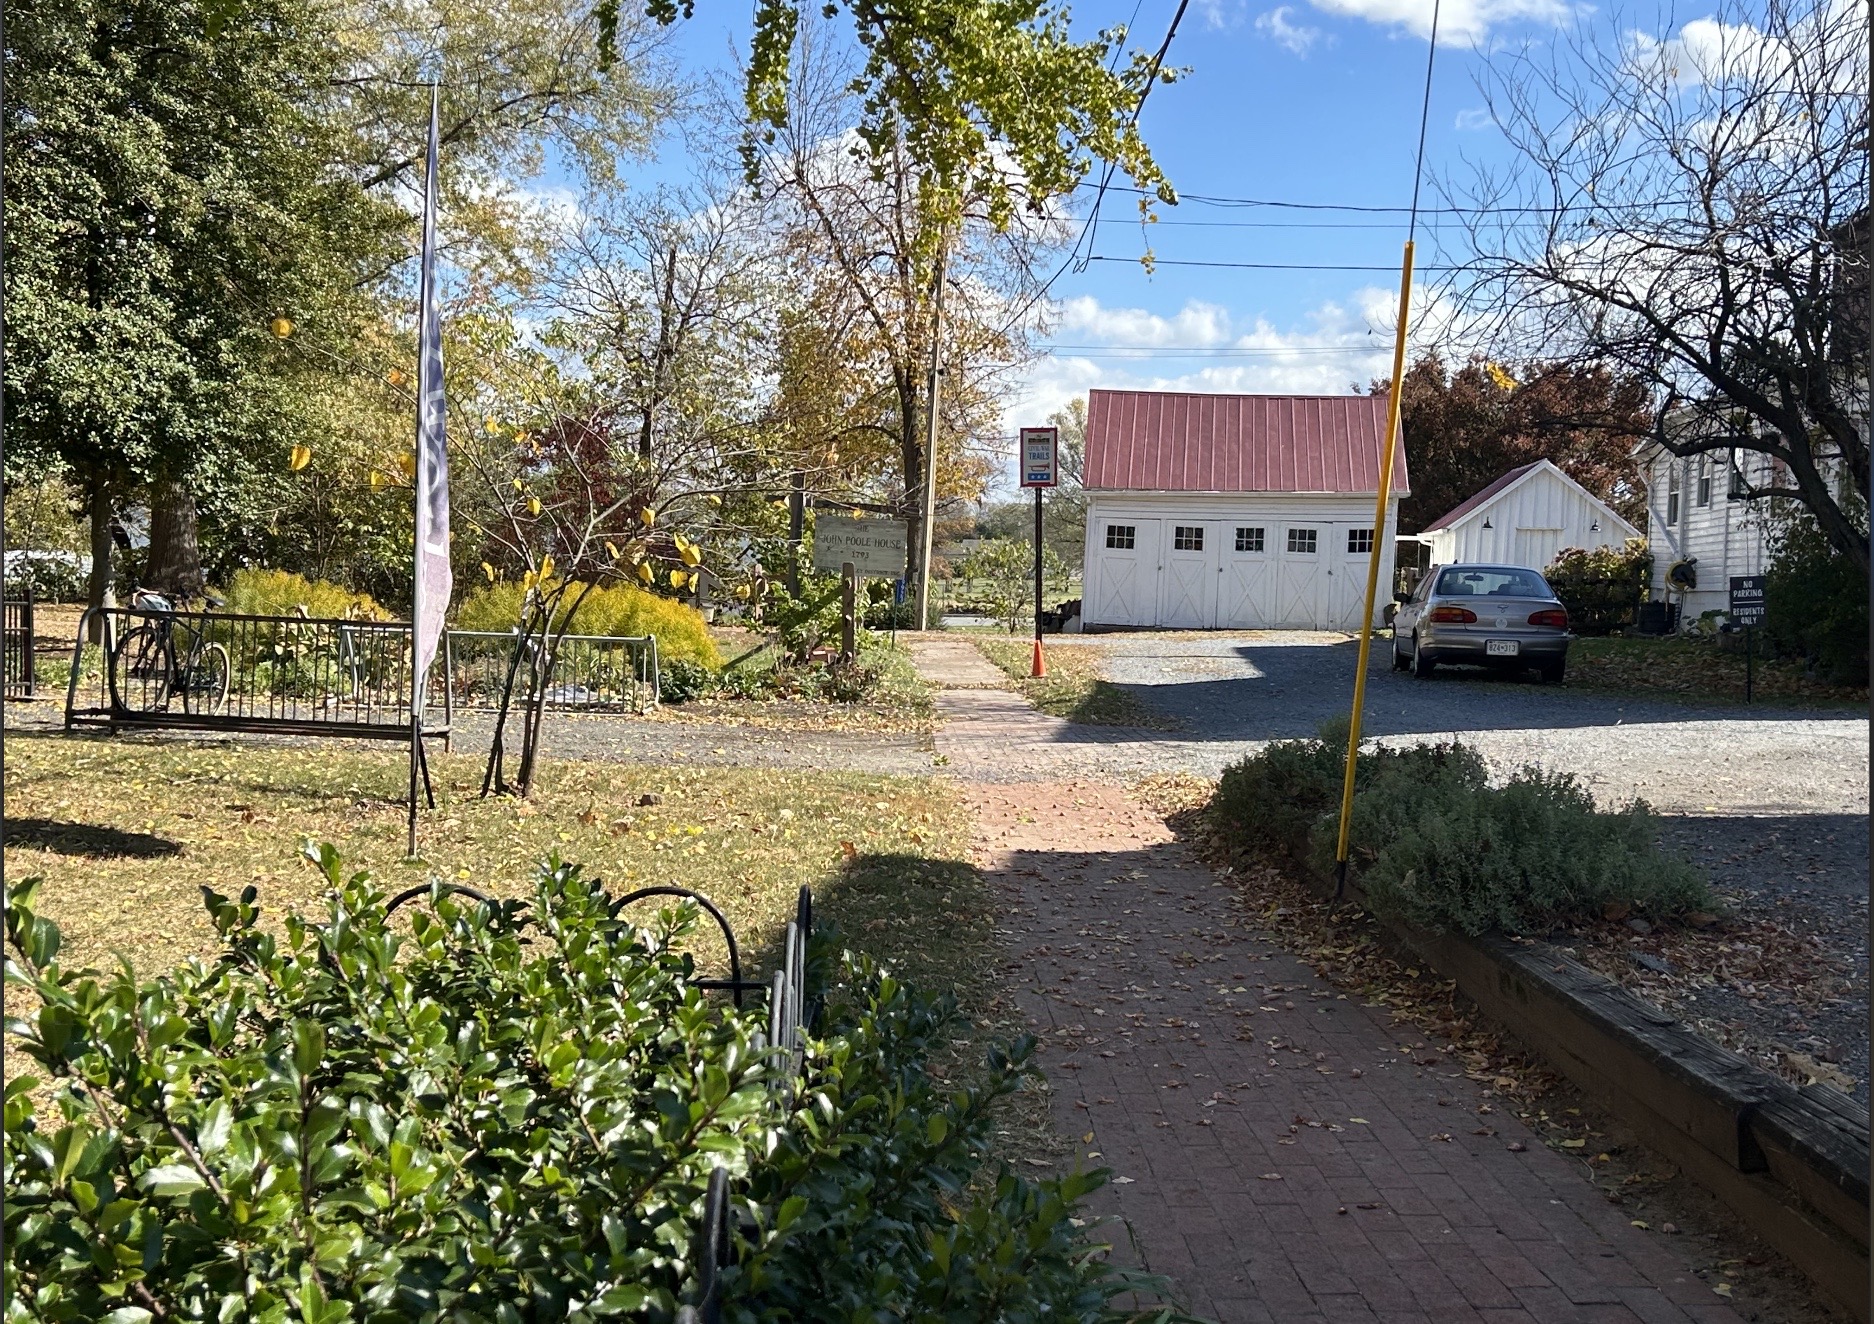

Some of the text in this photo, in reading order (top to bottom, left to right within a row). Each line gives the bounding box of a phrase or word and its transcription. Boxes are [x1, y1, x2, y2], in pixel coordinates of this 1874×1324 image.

[1028, 452, 1050, 460] TRAILS
[821, 535, 901, 549] JOHN POOLE HOUSE
[851, 551, 870, 559] 1793
[1733, 589, 1763, 597] PARKING
[1733, 607, 1764, 615] RESIDENTS
